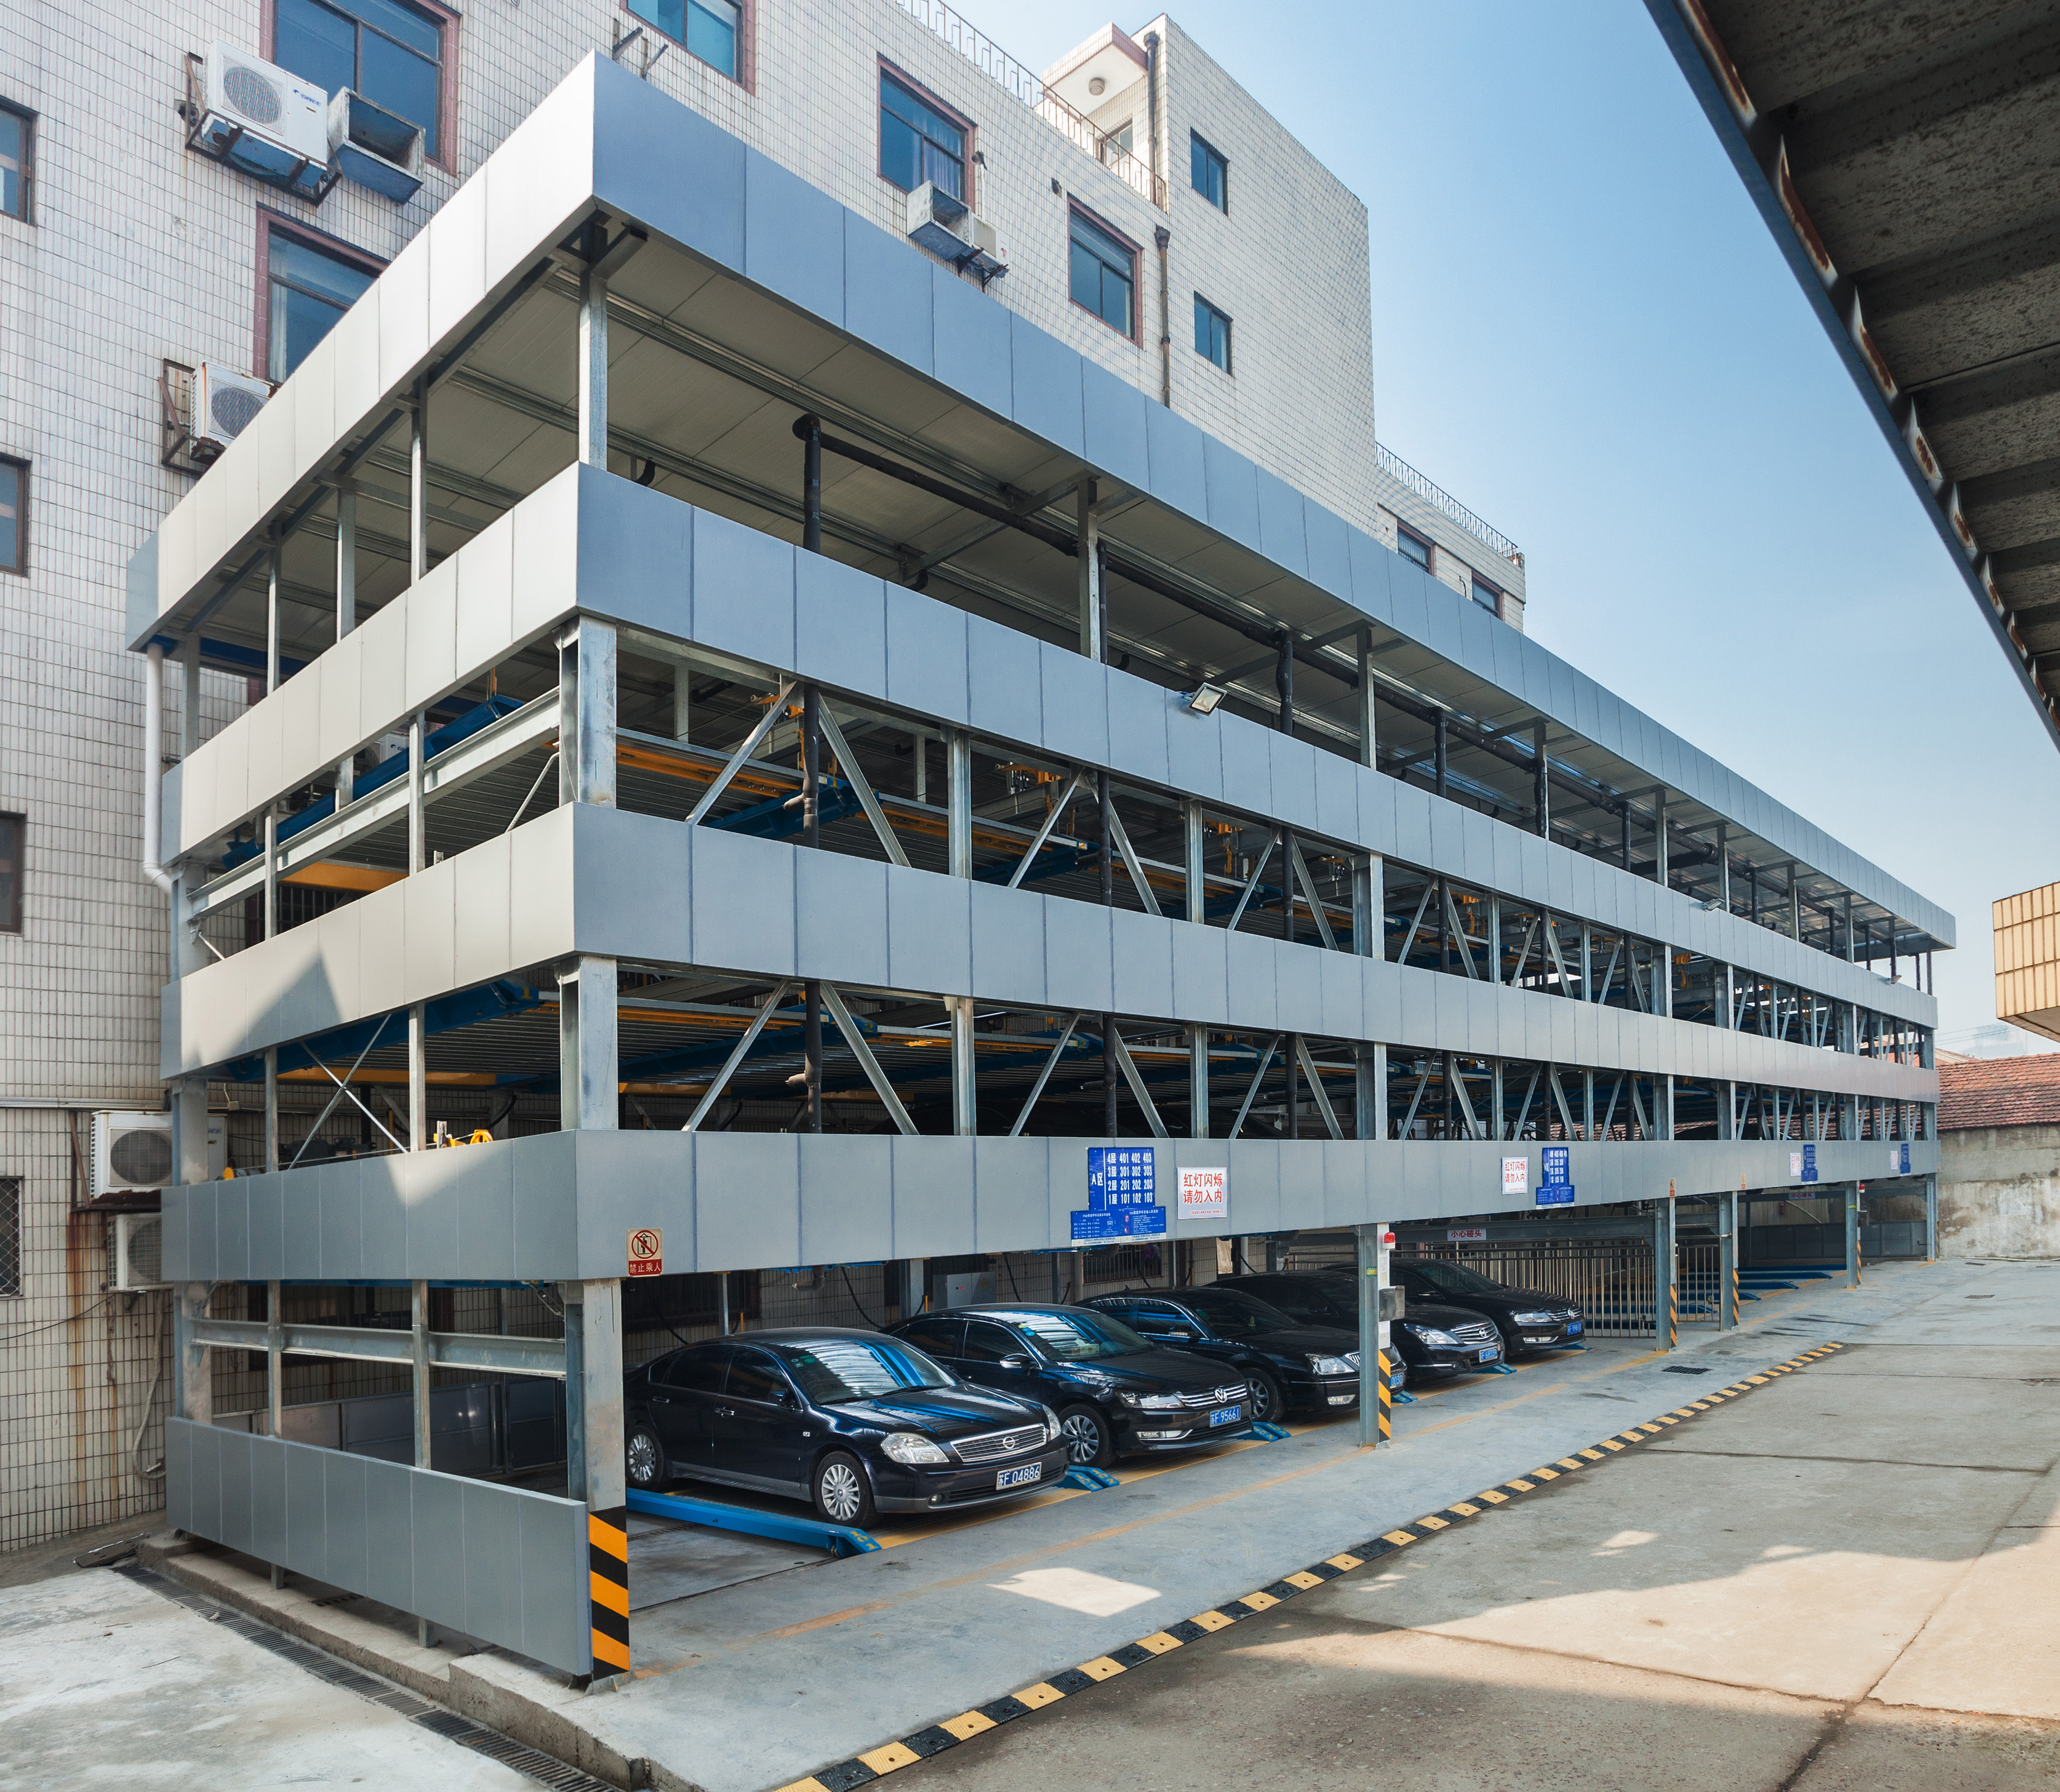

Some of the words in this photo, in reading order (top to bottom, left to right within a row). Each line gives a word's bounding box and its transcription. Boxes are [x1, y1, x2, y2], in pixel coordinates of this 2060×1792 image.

[1107, 1153, 1116, 1164] 4层
[1120, 1153, 1129, 1164] 401
[1131, 1153, 1141, 1163] 402
[1143, 1153, 1152, 1163] 403
[1108, 1166, 1117, 1177] 3层
[1120, 1166, 1129, 1177] 301
[1131, 1166, 1141, 1176] 302
[1143, 1165, 1152, 1176] 303
[1505, 1161, 1525, 1171] 红灯闪烁
[1184, 1173, 1222, 1187] 红灯闪烁
[1505, 1172, 1525, 1183] 请勿入内
[1108, 1180, 1117, 1191] 2层
[1120, 1179, 1130, 1190] 201
[1132, 1179, 1141, 1190] 202
[1143, 1179, 1153, 1189] 203
[1108, 1193, 1117, 1205] 1层
[1121, 1193, 1130, 1204] 101
[1132, 1192, 1141, 1203] 102
[1144, 1192, 1153, 1203] 103
[1183, 1189, 1222, 1204] 请勿入内
[1451, 1230, 1482, 1238] 小心碰头
[629, 1262, 661, 1273] 禁止乘人
